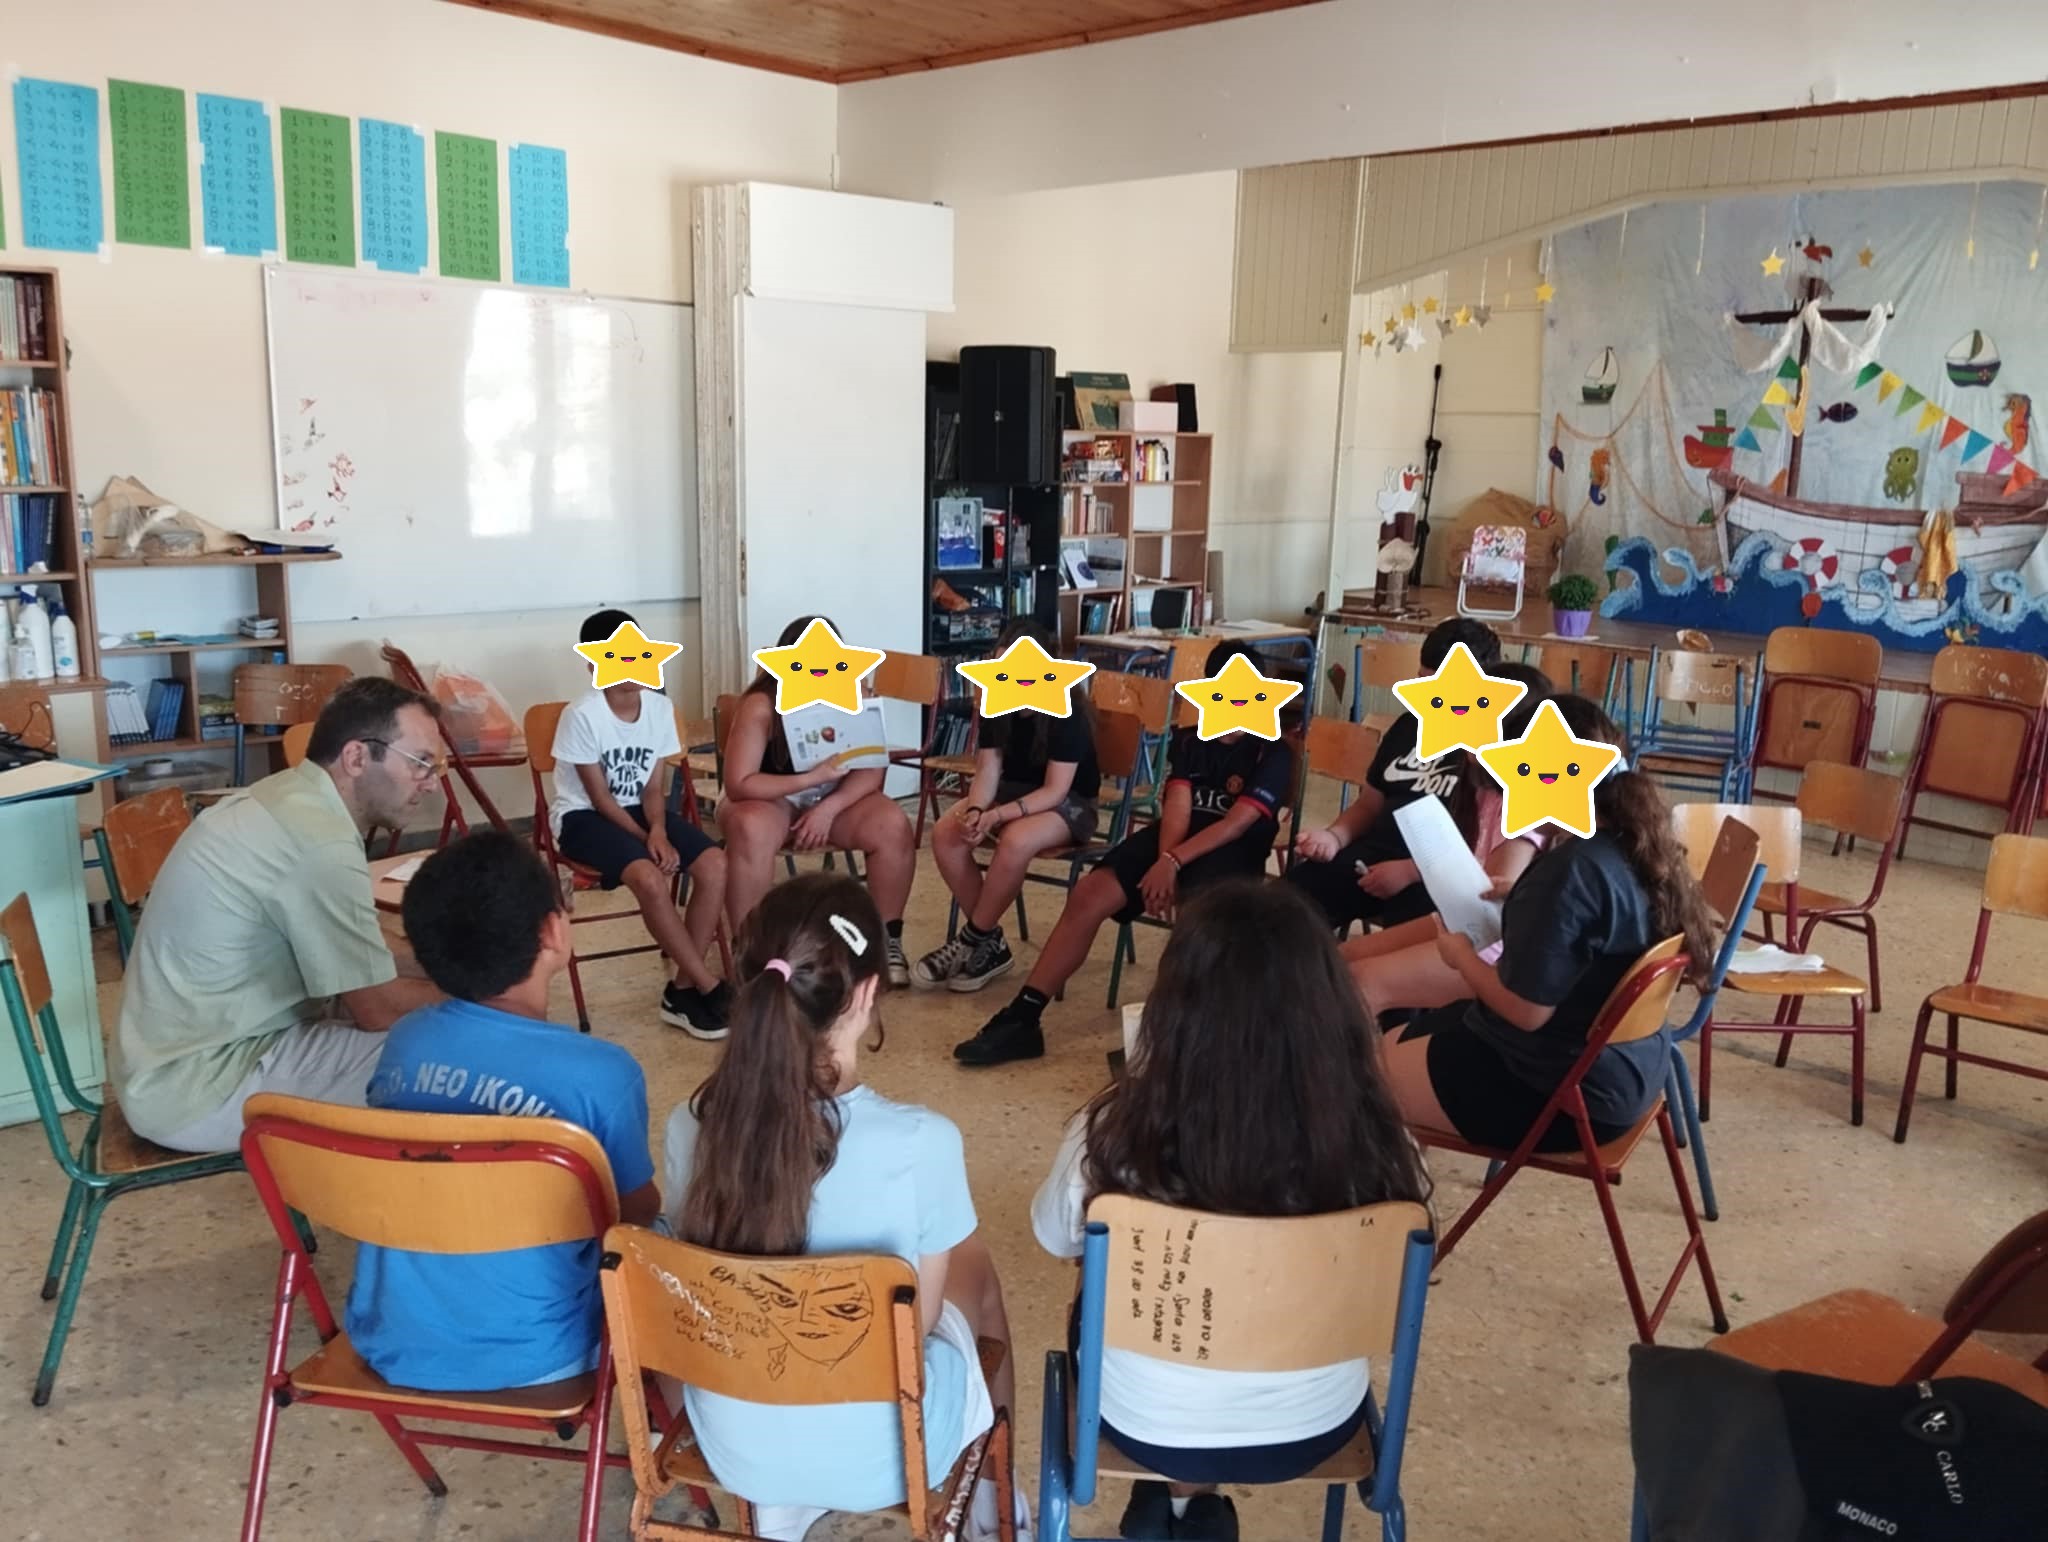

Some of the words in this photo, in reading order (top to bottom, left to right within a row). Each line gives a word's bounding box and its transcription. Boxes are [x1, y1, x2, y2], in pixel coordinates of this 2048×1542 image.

[609, 779, 645, 797] WILD
[615, 764, 638, 782] THE
[413, 1062, 468, 1098] NEO
[470, 1073, 556, 1117] IKON
[1937, 1450, 1964, 1504] CARLO
[1838, 1501, 1898, 1535] MONACO
